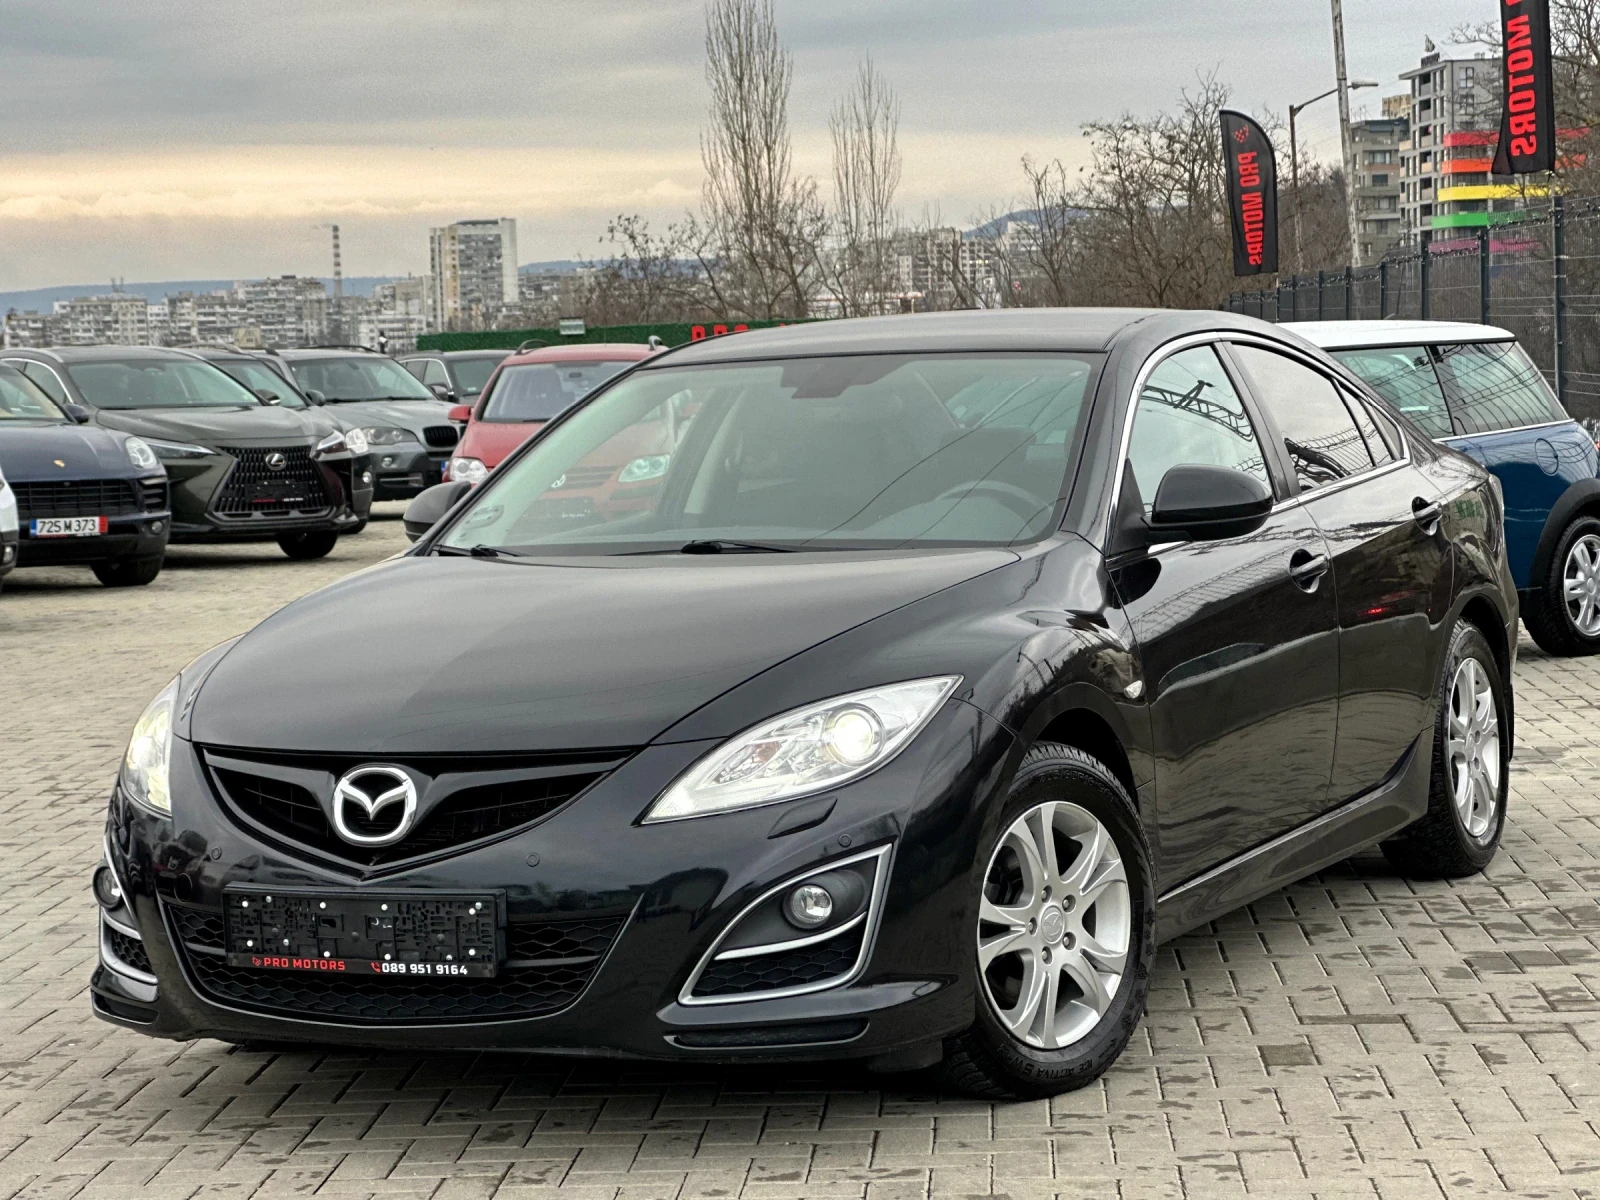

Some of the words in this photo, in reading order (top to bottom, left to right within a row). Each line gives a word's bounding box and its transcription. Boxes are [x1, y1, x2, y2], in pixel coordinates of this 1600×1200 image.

[38, 520, 61, 533] 725
[73, 519, 96, 532] 373
[263, 957, 289, 968] PRO
[292, 958, 346, 971] MOTORS
[381, 962, 407, 974] 089
[409, 963, 432, 975] 951
[436, 964, 468, 975] 9164
